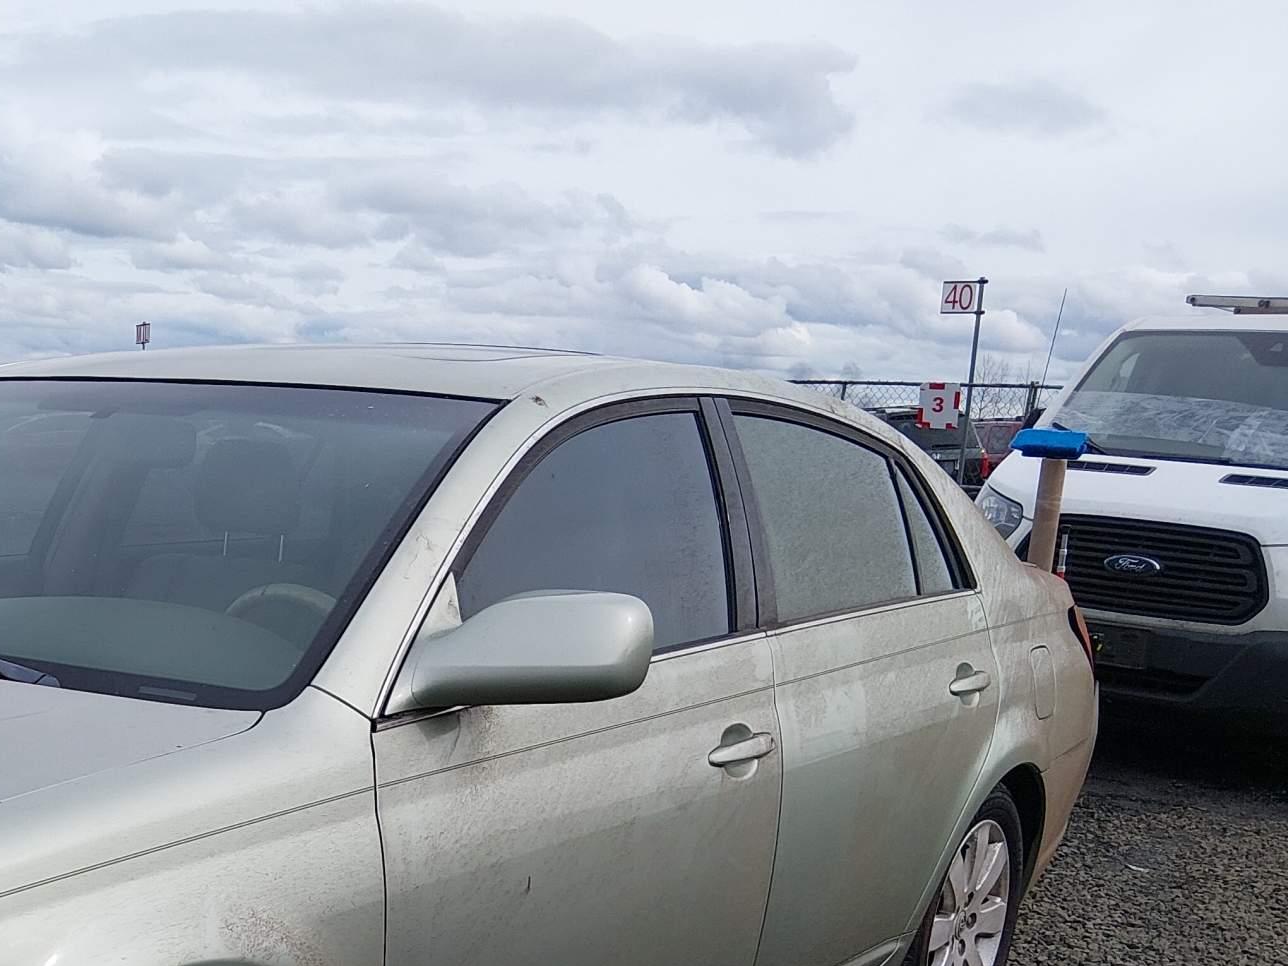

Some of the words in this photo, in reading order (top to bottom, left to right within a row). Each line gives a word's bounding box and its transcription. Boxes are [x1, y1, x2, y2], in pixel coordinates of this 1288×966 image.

[944, 284, 973, 310] 40
[932, 397, 944, 413] 3
[1114, 557, 1145, 570] Ford
